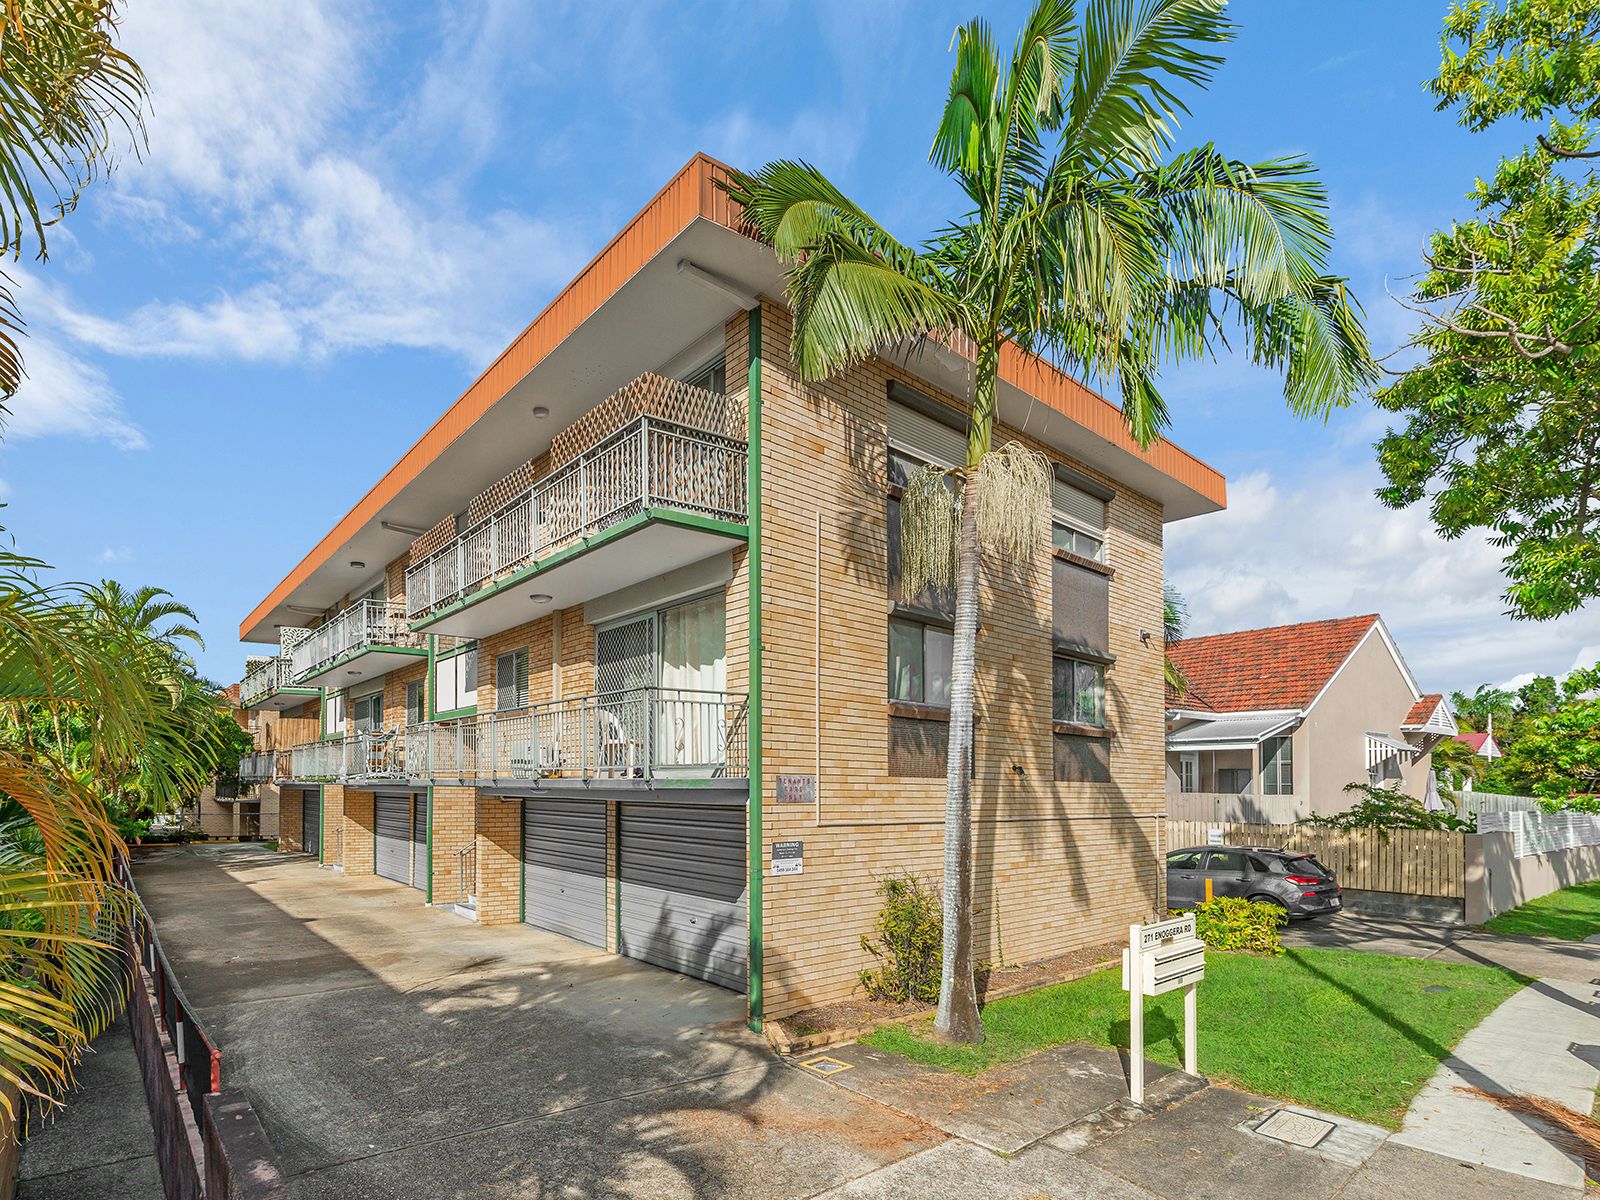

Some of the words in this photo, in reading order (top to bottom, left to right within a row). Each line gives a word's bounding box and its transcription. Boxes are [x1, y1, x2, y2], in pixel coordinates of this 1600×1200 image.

[1144, 933, 1153, 943] 271
[1155, 926, 1183, 940] ENOGGERA
[1184, 924, 1192, 933] RD
